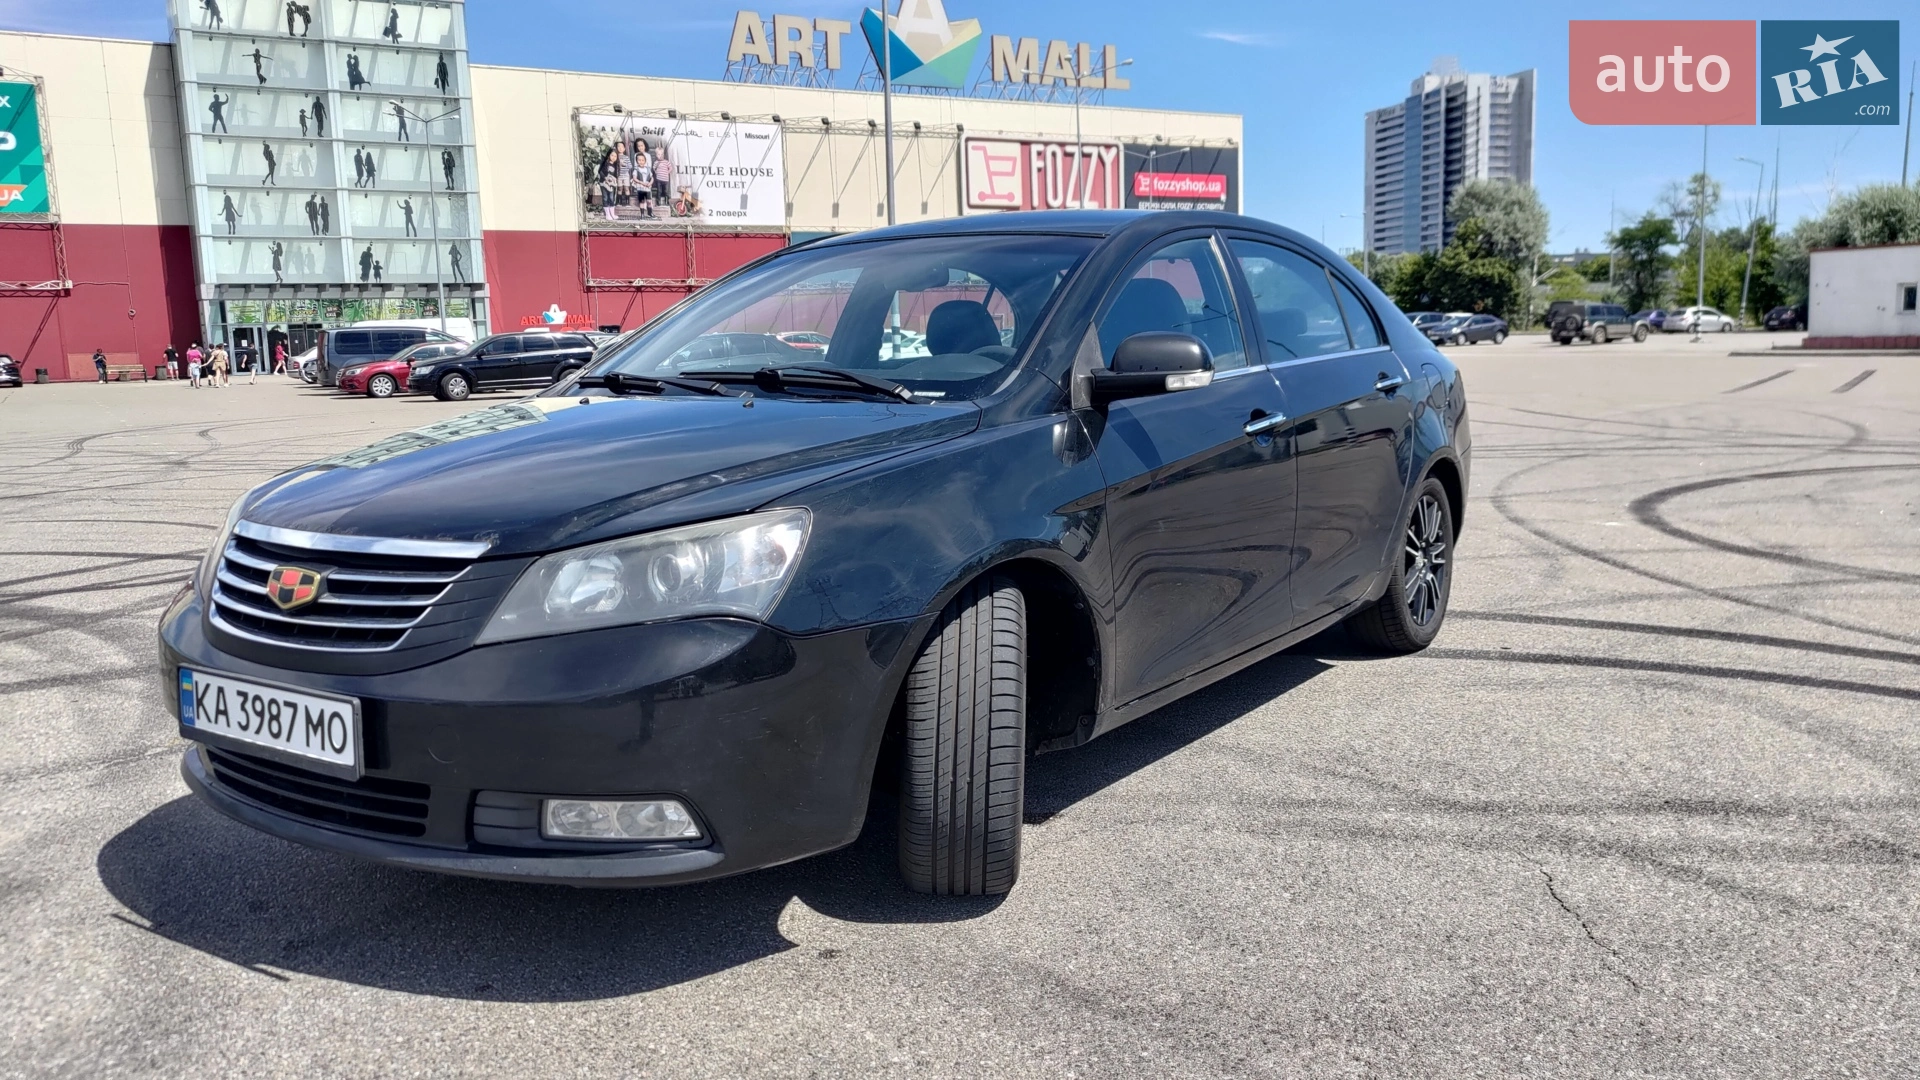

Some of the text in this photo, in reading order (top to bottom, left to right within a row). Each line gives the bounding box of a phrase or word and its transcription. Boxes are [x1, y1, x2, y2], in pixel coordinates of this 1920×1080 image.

[727, 10, 1130, 89] ART MALL
[592, 125, 635, 134] FALKE
[642, 126, 666, 137] Steiff
[744, 132, 770, 140] Missouri
[676, 165, 774, 177] LITTLE HOUSE
[1030, 143, 1118, 209] FOZZY
[706, 180, 747, 189] OUTLET
[1153, 177, 1222, 193] fozzyshop.ua
[708, 209, 747, 218] 2 поверх
[521, 314, 595, 326] ART MALL
[183, 705, 194, 719] UA
[195, 680, 348, 754] KA 3987 MO
